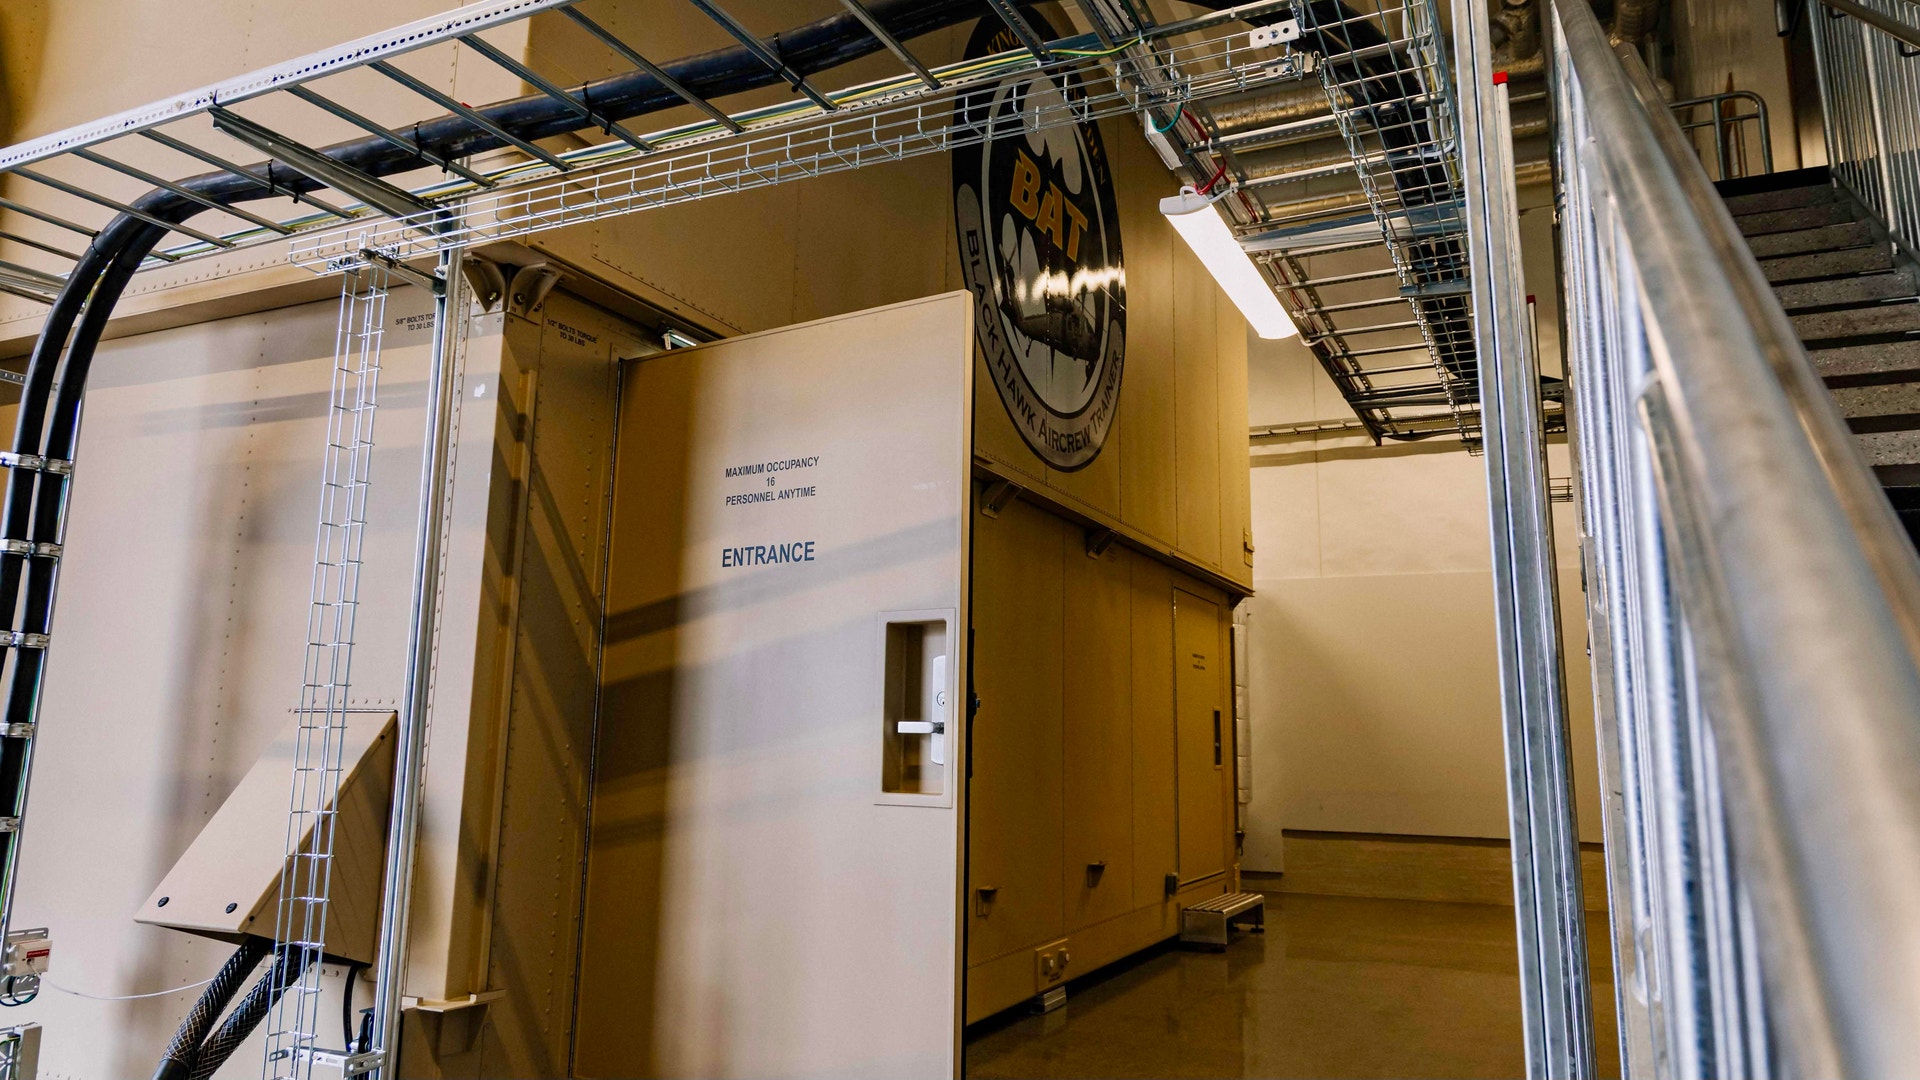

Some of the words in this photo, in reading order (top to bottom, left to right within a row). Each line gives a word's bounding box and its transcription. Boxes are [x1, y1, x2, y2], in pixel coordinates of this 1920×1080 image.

[1010, 148, 1088, 262] BAT
[407, 314, 425, 324] BOLTS
[558, 322, 576, 335] BOLTS
[966, 229, 999, 349] BLACK
[998, 350, 1036, 430] HAWK
[1038, 423, 1091, 453] AIRCREW
[1090, 350, 1120, 434] TRAINER
[725, 463, 765, 478] MAXIMUM
[766, 456, 820, 473] OCCUPANCY
[766, 476, 776, 487] 16
[725, 491, 776, 506] PERSONNEL
[778, 486, 816, 500] ANYTIME
[722, 541, 815, 568] ENTRANCE
